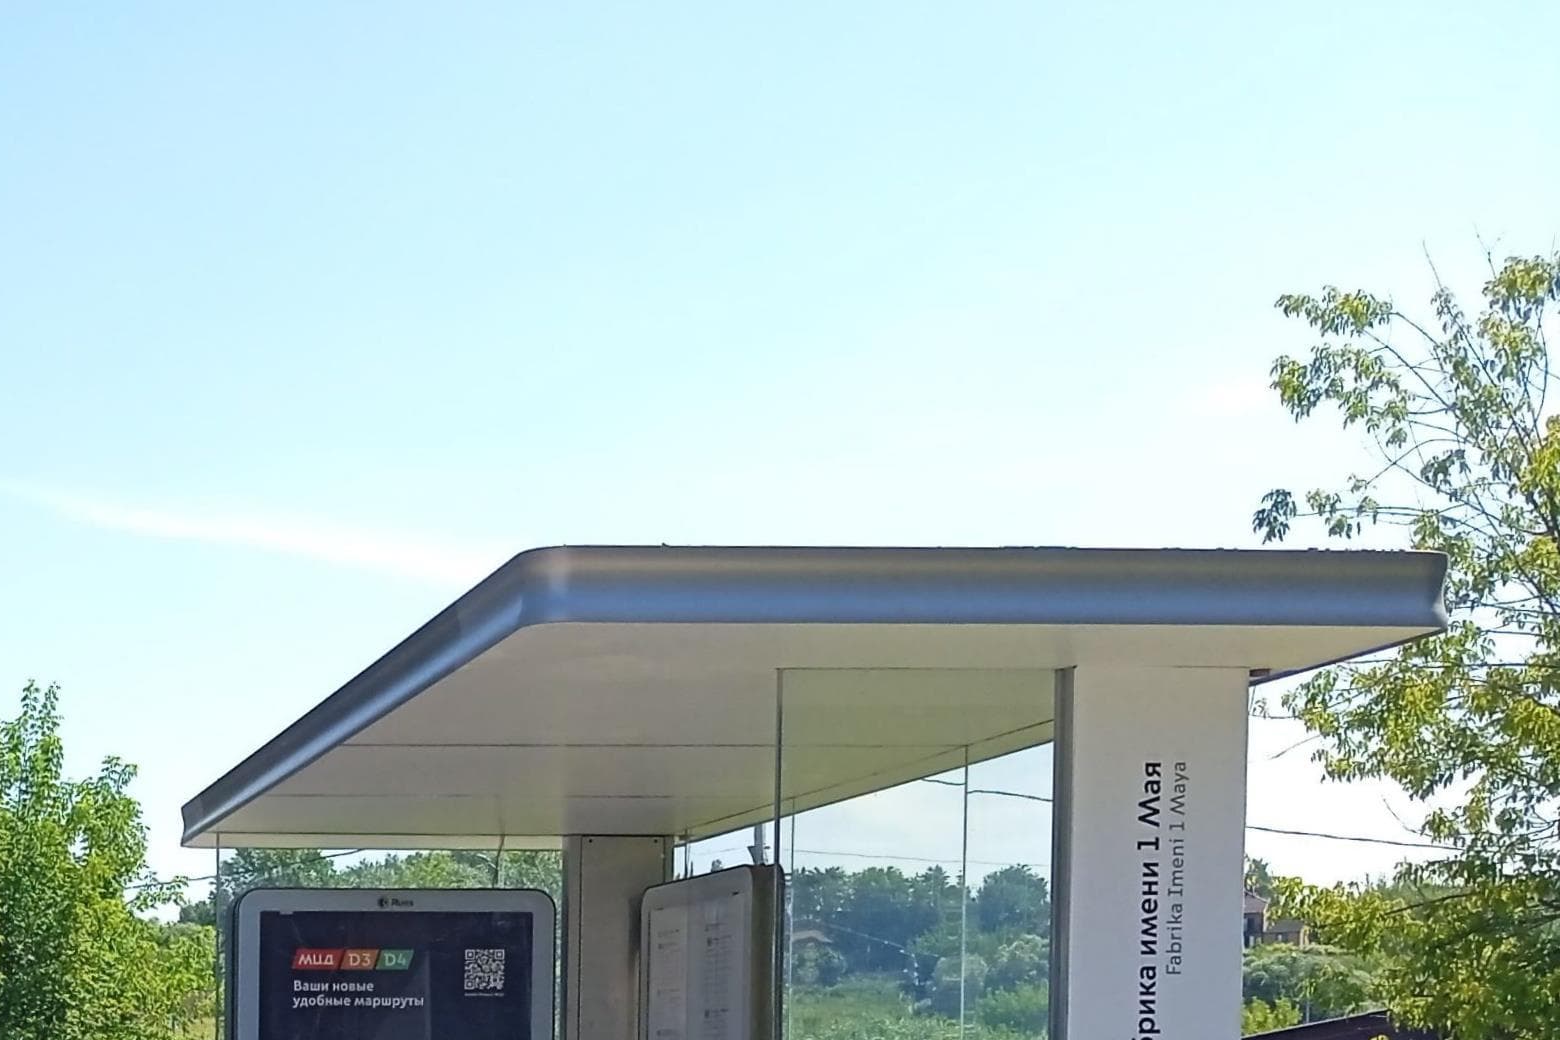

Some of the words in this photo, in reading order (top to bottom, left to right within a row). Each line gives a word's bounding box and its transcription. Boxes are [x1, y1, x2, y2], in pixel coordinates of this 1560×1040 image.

[1138, 762, 1162, 828] Мая
[1169, 761, 1190, 816] Maya
[1137, 836, 1160, 851] 1
[1169, 821, 1185, 831] 1
[1167, 837, 1184, 897] Imeni
[1140, 861, 1160, 956] имени
[1166, 903, 1183, 975] Fabrika
[347, 952, 372, 966] D3
[383, 952, 407, 966] D4
[292, 994, 352, 1009] удобные
[354, 996, 425, 1009] маршруты
[293, 979, 329, 993] Ваши
[332, 982, 375, 993] новые
